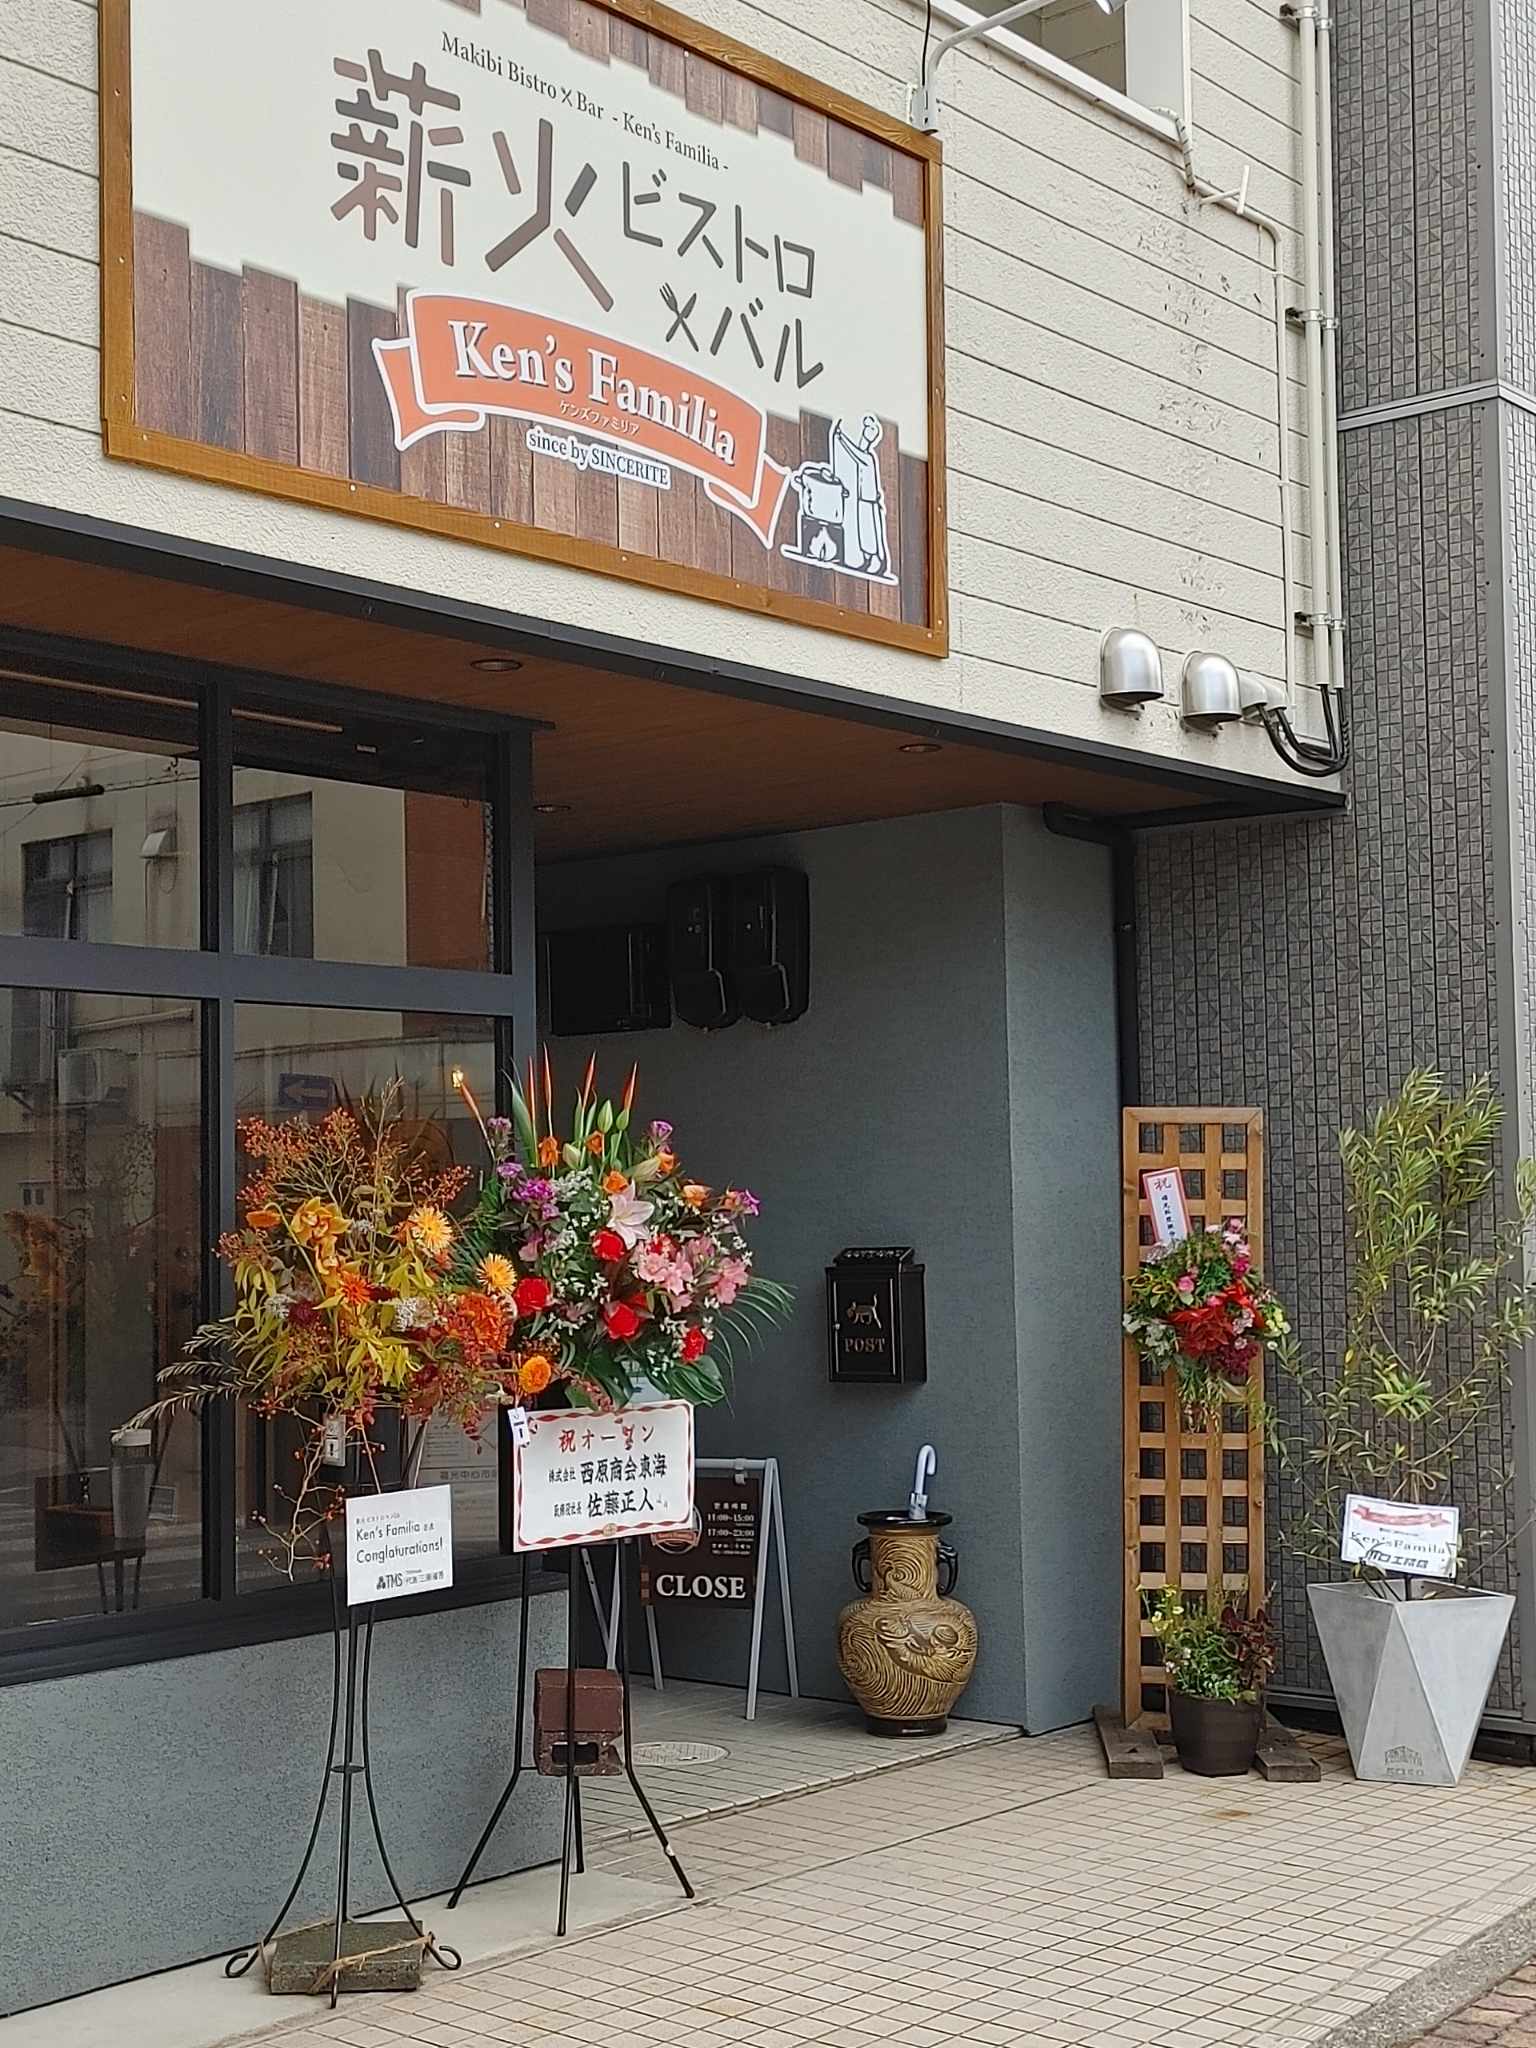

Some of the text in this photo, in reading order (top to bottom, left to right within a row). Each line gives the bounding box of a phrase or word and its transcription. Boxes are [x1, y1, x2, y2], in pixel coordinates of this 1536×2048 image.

[441, 31, 503, 76] Makibi
[508, 60, 557, 100] Bistro
[576, 91, 605, 120] Bar
[622, 112, 661, 145] Ken's
[665, 130, 720, 170] Familia
[331, 48, 816, 312] 薪火 ビストロ
[448, 320, 736, 466] Ken's Familia
[559, 400, 640, 435] ケンズファミリア
[528, 430, 668, 486] since by SINCERITE
[844, 1337, 885, 1353] POST
[548, 1467, 576, 1483] 株式会社
[587, 1487, 654, 1518] 佐藤正人
[356, 1526, 383, 1542] Ken's
[386, 1520, 420, 1537] Familia
[385, 1573, 403, 1589] TMS
[656, 1574, 747, 1599] CLOSE
